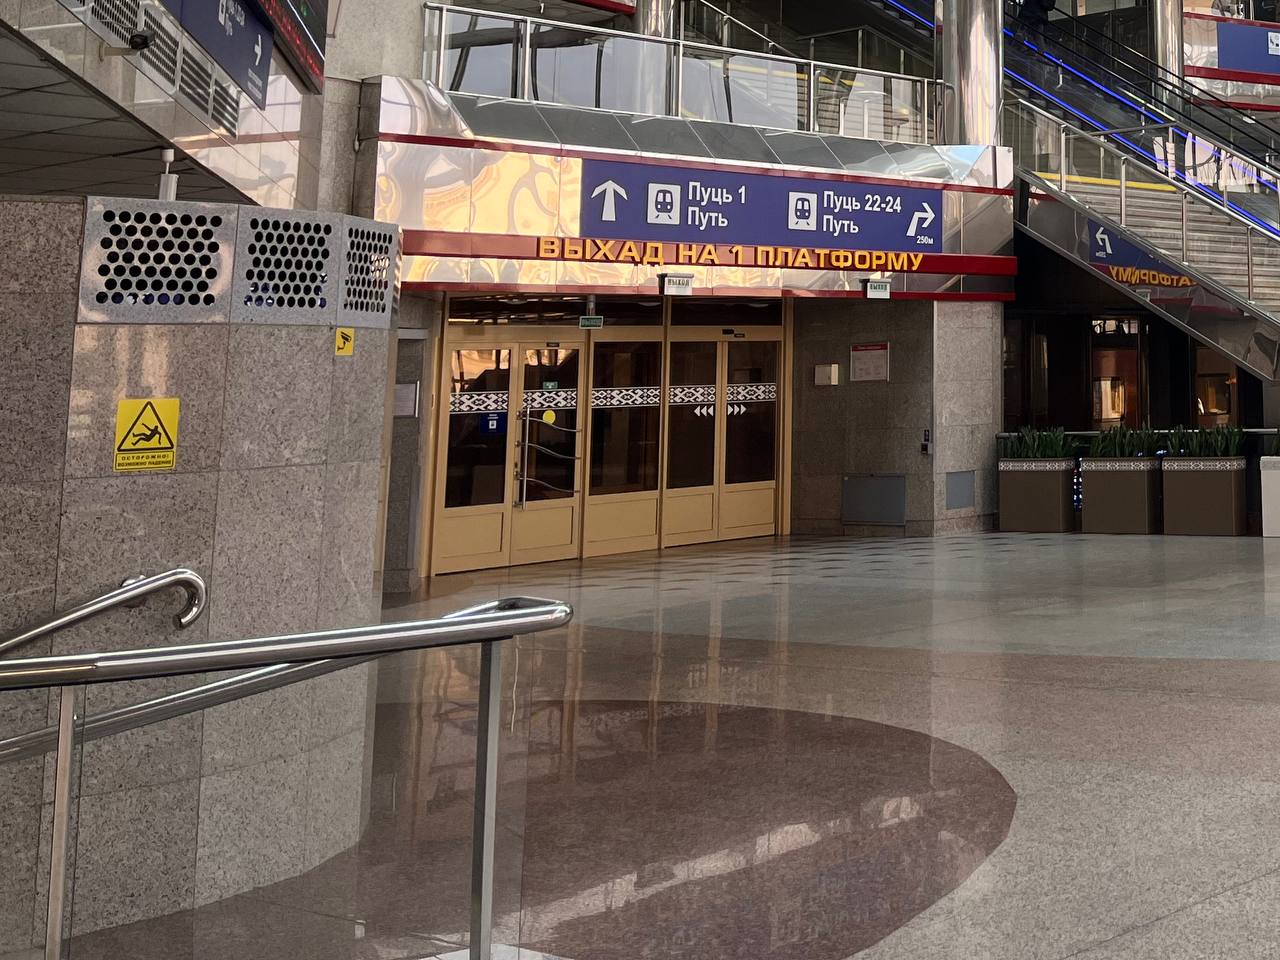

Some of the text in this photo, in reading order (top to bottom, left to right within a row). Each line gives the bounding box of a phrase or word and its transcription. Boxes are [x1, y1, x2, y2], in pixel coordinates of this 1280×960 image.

[688, 181, 747, 206] Пуць 1
[823, 191, 902, 213] Пуць 22-24
[687, 206, 729, 230] Путь
[822, 215, 859, 236] Путь
[917, 236, 934, 245] 250м
[537, 237, 925, 271] ВЫХАД НА 1 ПЛАТФОРМУ
